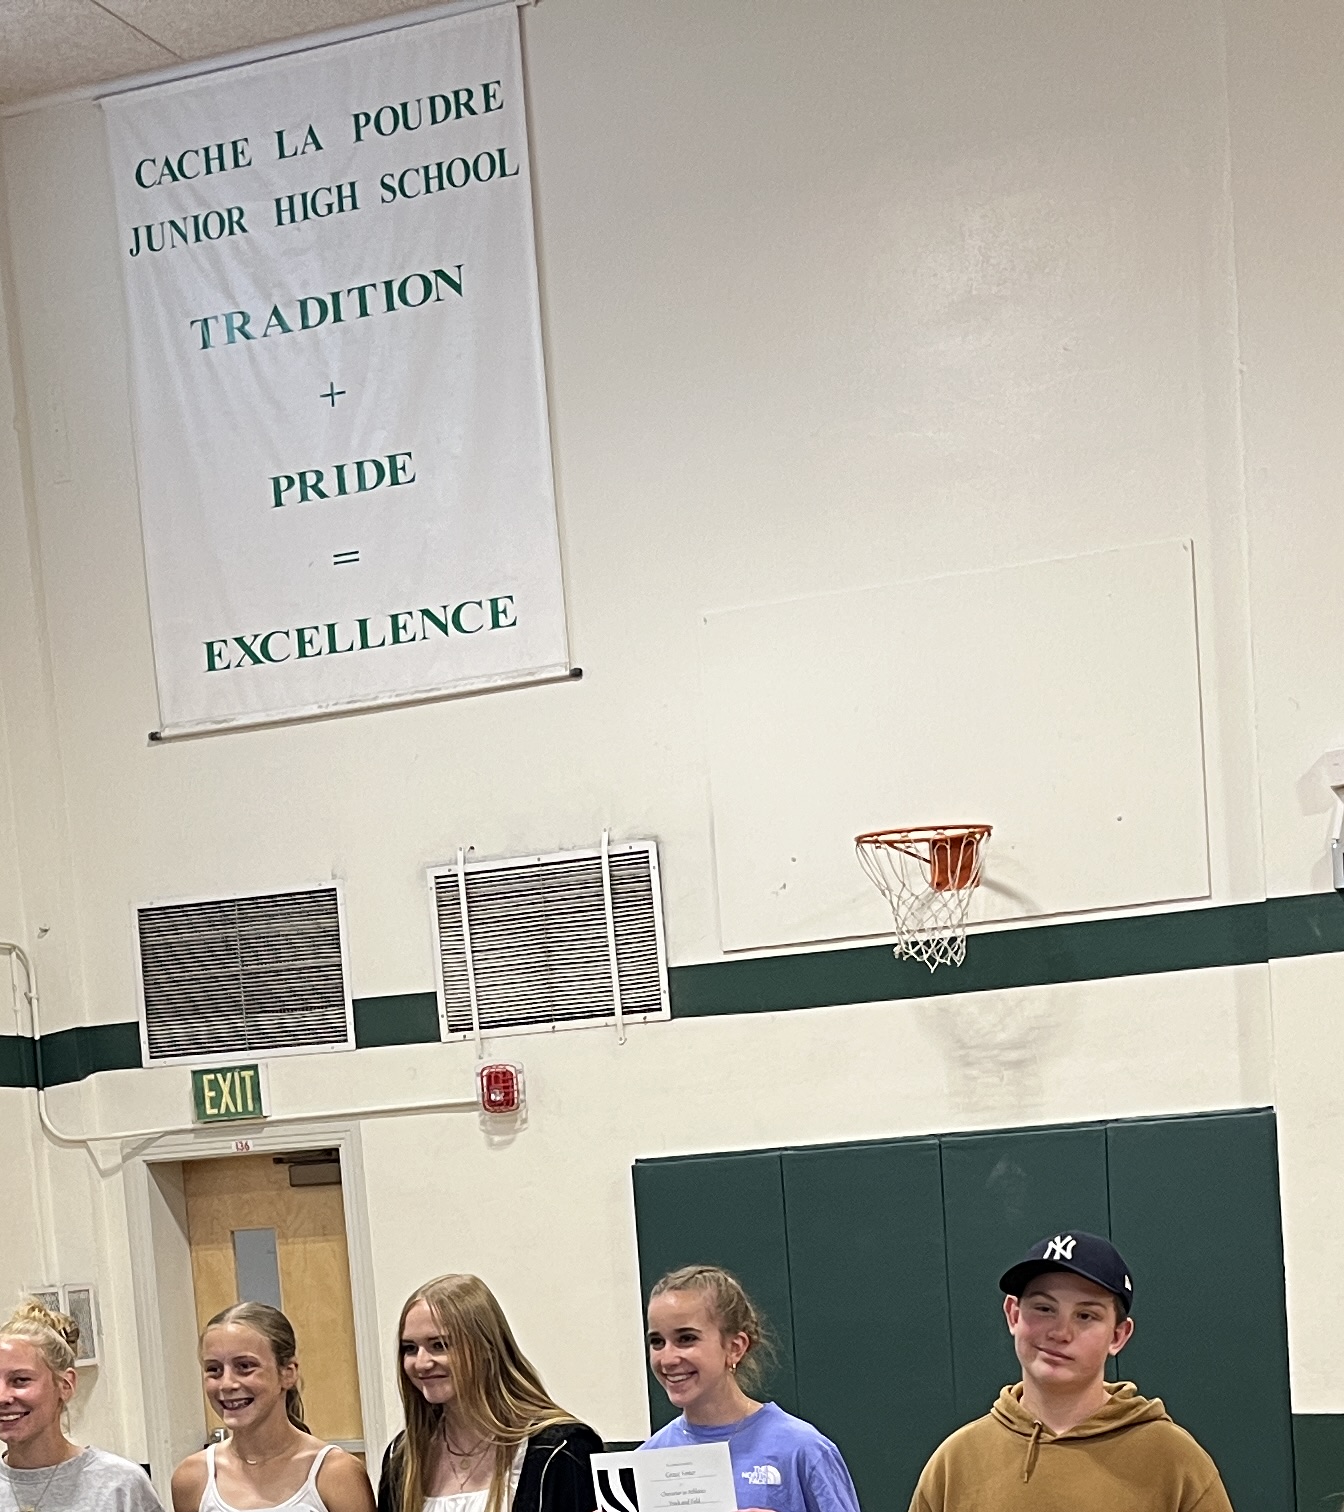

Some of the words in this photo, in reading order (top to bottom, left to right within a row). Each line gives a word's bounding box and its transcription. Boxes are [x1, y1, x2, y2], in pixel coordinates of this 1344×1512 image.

[135, 138, 252, 189] CACHE
[276, 123, 323, 161] LA
[353, 81, 505, 144] POUDRE
[128, 205, 249, 257] JUNIOR
[274, 182, 360, 228] HIGH
[380, 148, 519, 203] SCHOOL
[191, 264, 466, 350] TRADITION
[270, 452, 417, 508] PRIDE
[203, 595, 518, 673] EXCELLENCE
[203, 1070, 254, 1115] EXIT
[1043, 1235, 1077, 1260] NY
